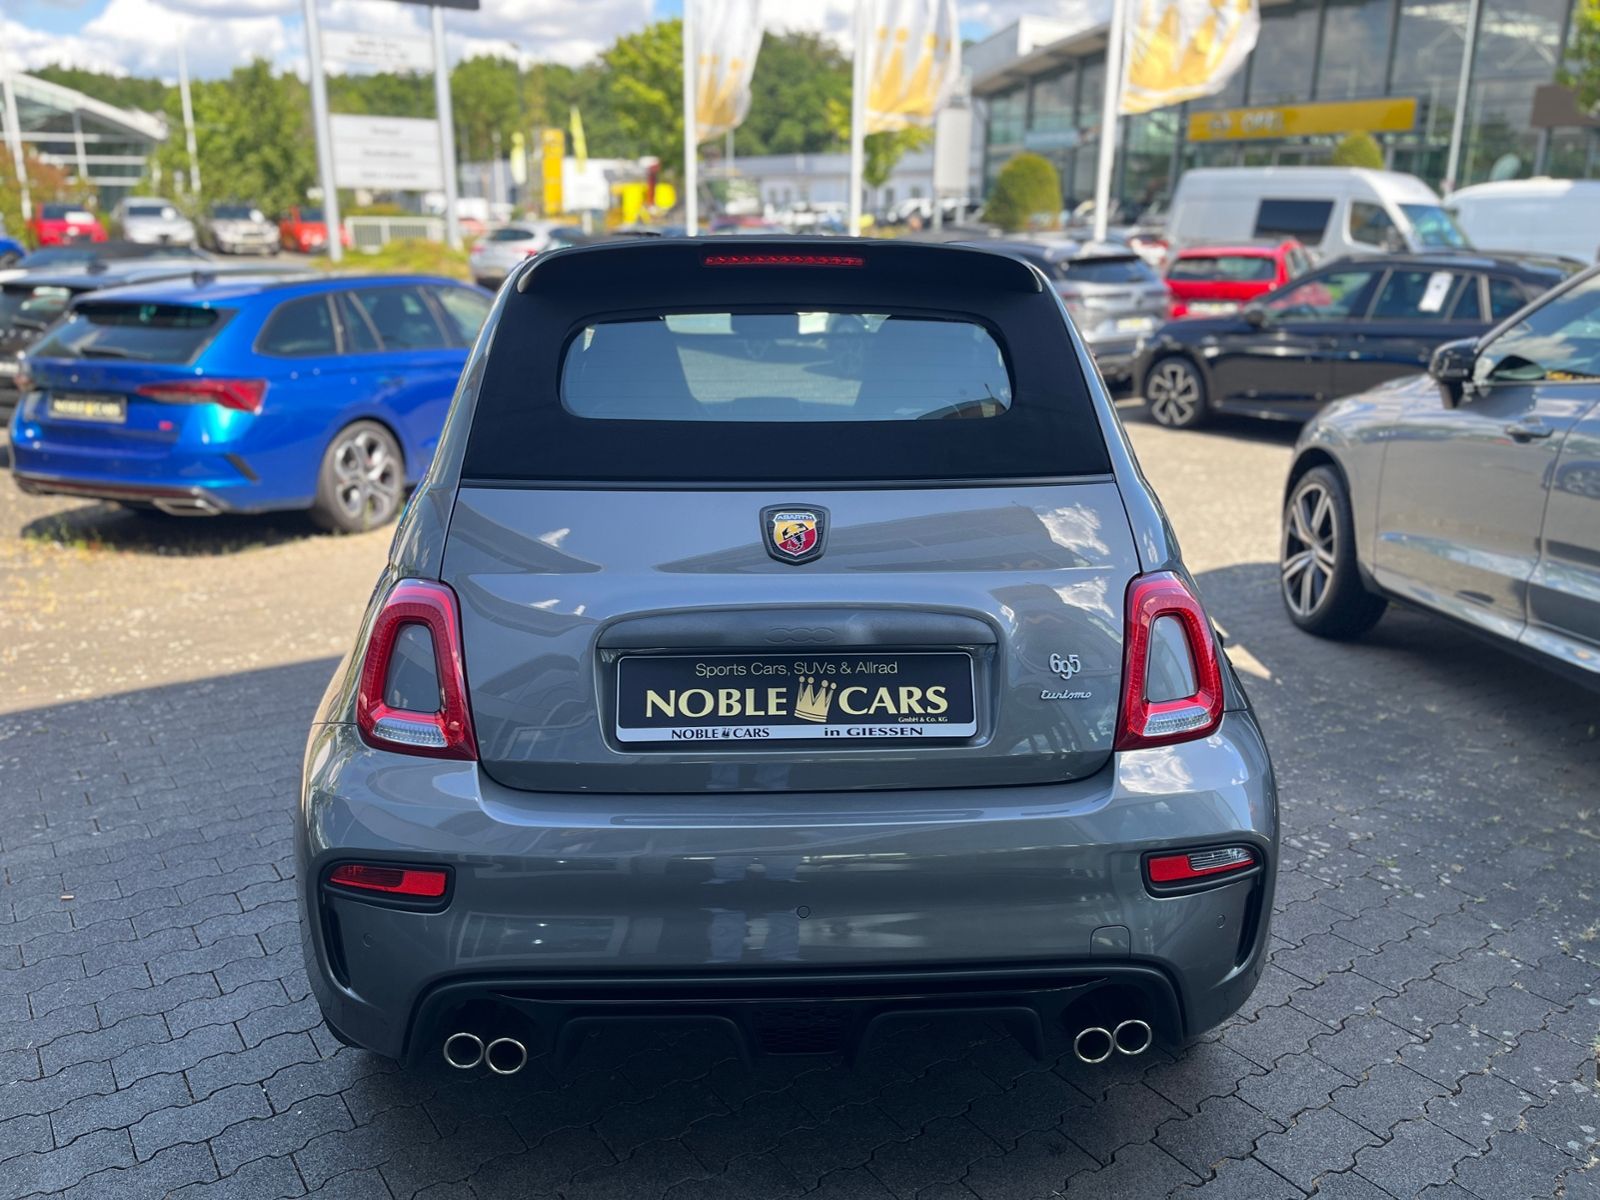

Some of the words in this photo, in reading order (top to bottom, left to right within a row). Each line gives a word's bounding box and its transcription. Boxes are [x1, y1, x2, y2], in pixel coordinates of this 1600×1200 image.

[695, 662, 747, 678] Sports
[750, 662, 791, 676] Cars,
[793, 661, 836, 675] SUVs
[840, 661, 852, 674] &
[855, 661, 898, 674] Allrad
[1049, 653, 1081, 680] 695
[645, 687, 788, 718] NOBLE
[838, 685, 949, 715] CARS
[1040, 689, 1092, 700] turismo
[671, 728, 719, 740] NOBLE
[732, 727, 770, 738] CARS
[824, 727, 841, 737] in
[846, 726, 924, 737] GIESSEN
